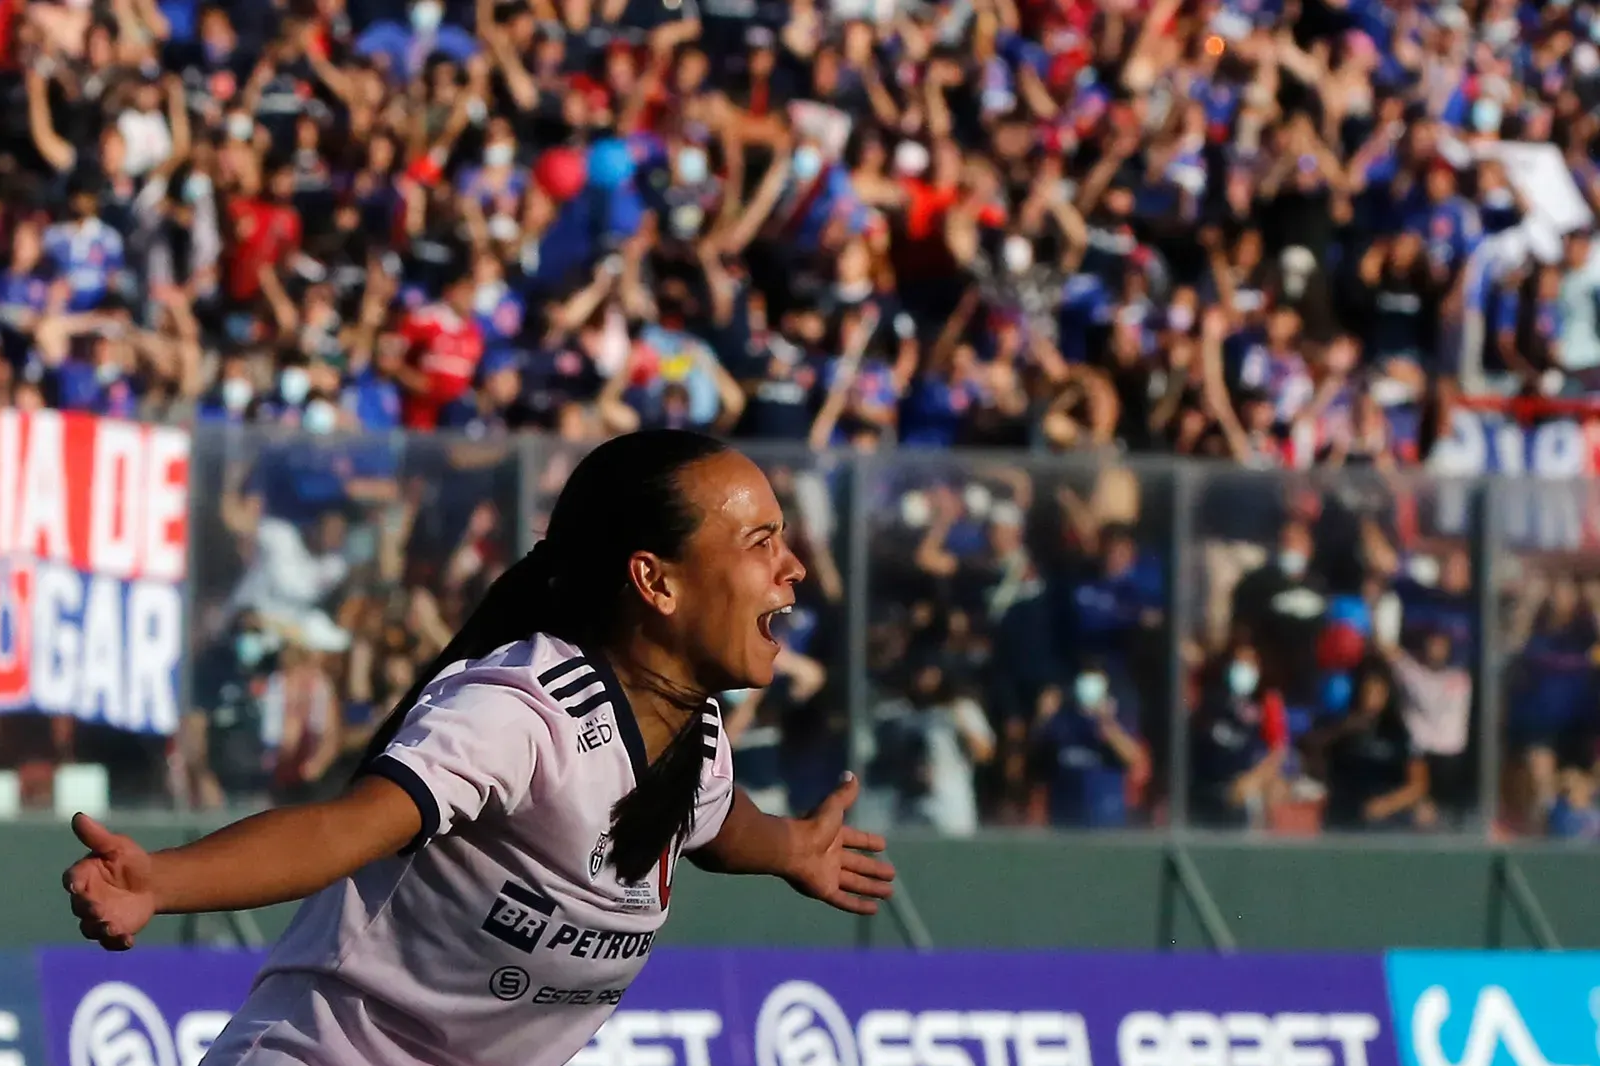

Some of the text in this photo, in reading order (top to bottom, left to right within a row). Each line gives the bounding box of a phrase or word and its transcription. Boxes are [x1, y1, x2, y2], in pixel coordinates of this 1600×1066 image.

[90, 420, 190, 580] DE
[492, 901, 657, 960] BR PETROB
